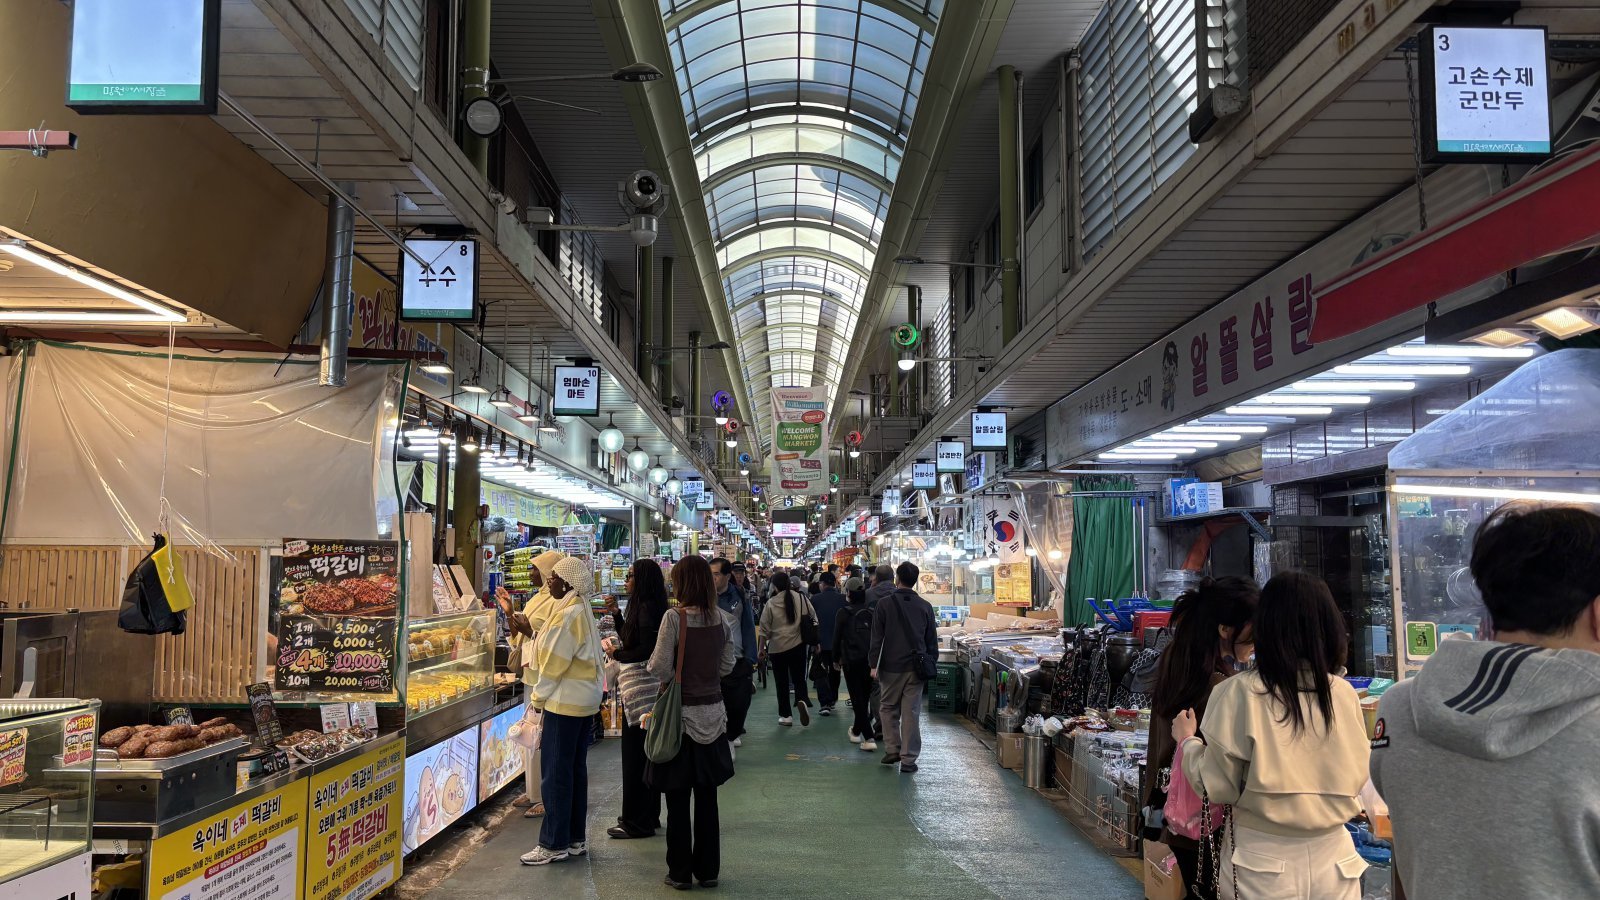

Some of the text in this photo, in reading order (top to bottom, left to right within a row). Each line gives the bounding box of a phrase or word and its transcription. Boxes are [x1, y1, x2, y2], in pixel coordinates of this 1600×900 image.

[1438, 34, 1450, 50] 3
[1448, 66, 1534, 87] 고손수제
[1459, 91, 1524, 110] 군만두
[460, 245, 468, 256] 8
[1190, 272, 1314, 397] 알뜰살림
[563, 378, 590, 388] 엄마손
[567, 389, 585, 400] 마트
[310, 554, 365, 577] 떡갈비
[295, 623, 375, 634] 1개 3,500원
[295, 636, 374, 648] 2개 6,000원
[281, 650, 388, 671] BEST 4개 10,000원
[288, 675, 309, 686] 10개
[325, 676, 363, 687] 20,000원
[314, 781, 338, 811] 옥이네
[352, 764, 374, 791] 떡갈비
[337, 806, 348, 823] 구워
[349, 800, 359, 816] 기름
[193, 818, 228, 852] 옥이네
[232, 812, 247, 834] 수제
[252, 795, 281, 825] 떡갈비
[352, 803, 388, 846] 떡갈비
